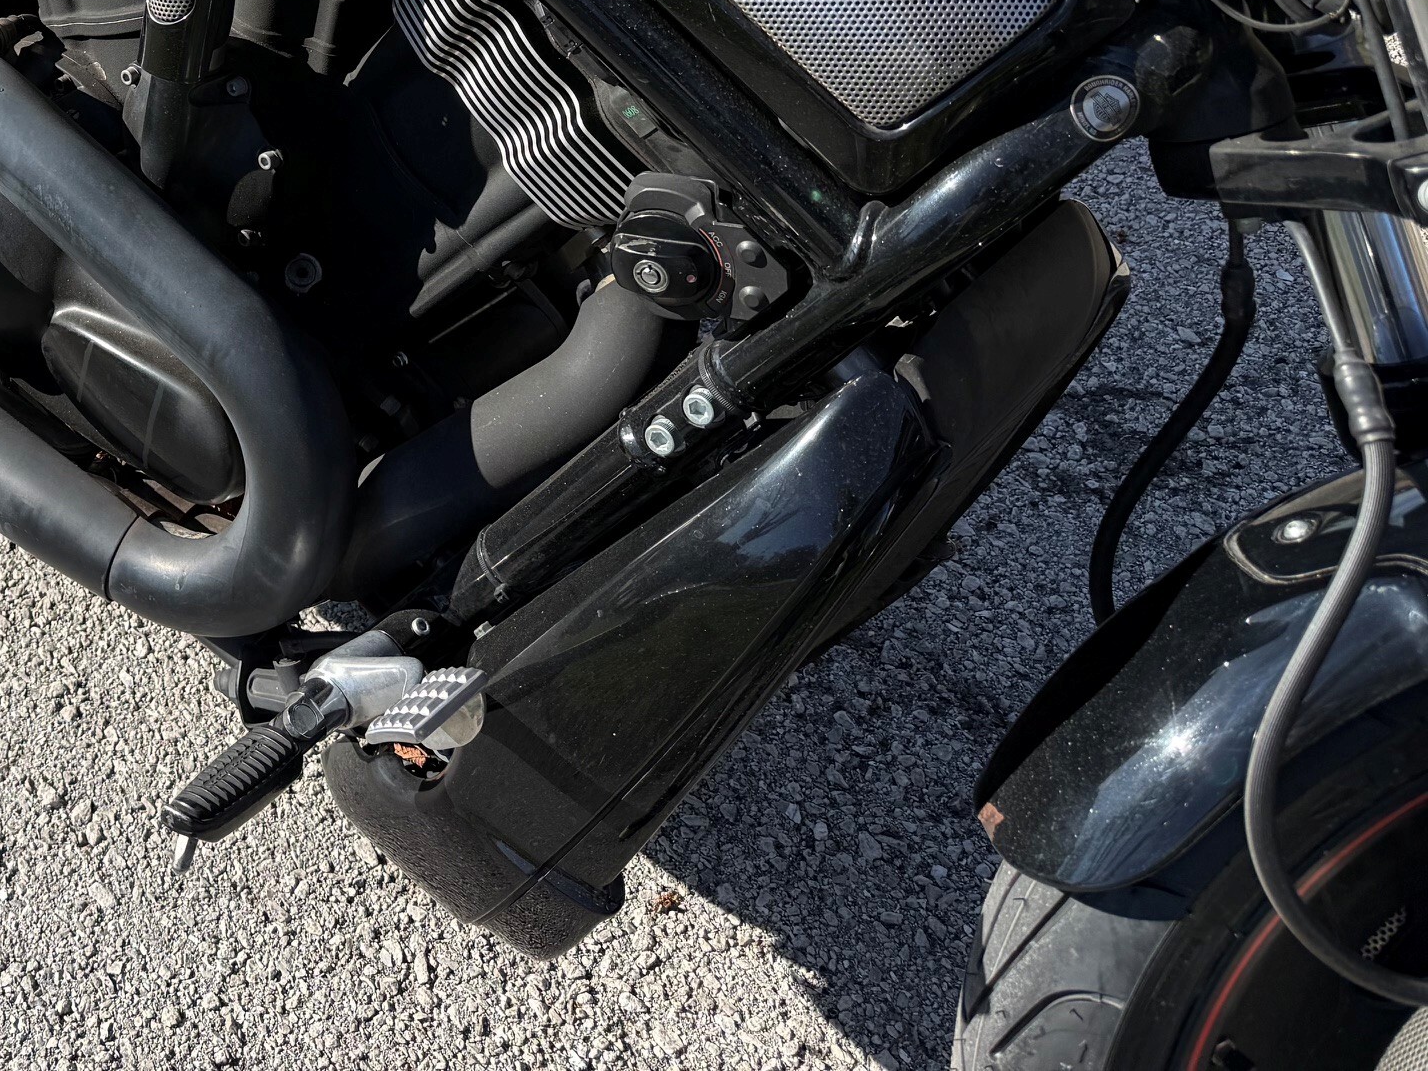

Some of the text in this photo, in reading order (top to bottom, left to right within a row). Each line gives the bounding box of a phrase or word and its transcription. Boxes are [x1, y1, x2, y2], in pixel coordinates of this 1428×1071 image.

[708, 231, 724, 248] ACC
[724, 262, 732, 278] OFF
[716, 290, 728, 304] IGN
